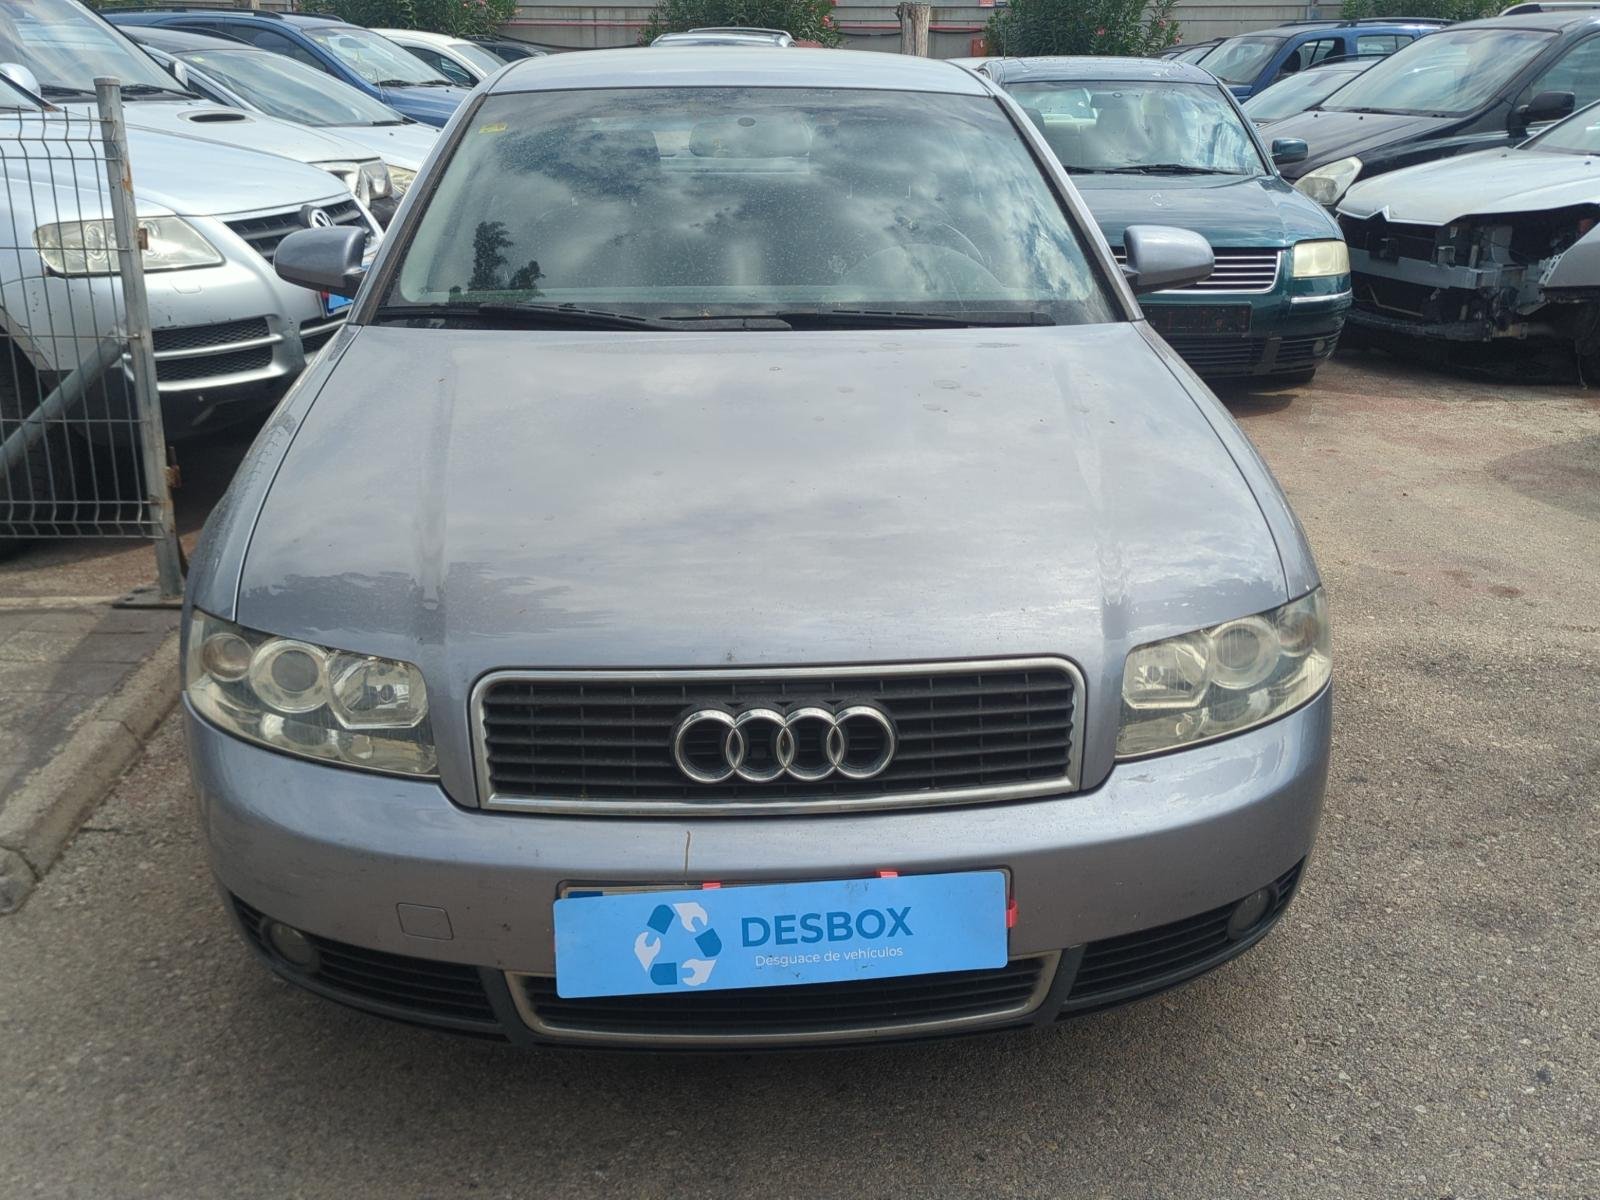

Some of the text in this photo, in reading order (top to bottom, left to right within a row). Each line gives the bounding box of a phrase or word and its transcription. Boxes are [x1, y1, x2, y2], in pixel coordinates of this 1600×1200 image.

[741, 906, 913, 947] DESBOX
[755, 946, 904, 968] Desguace de vehículos
